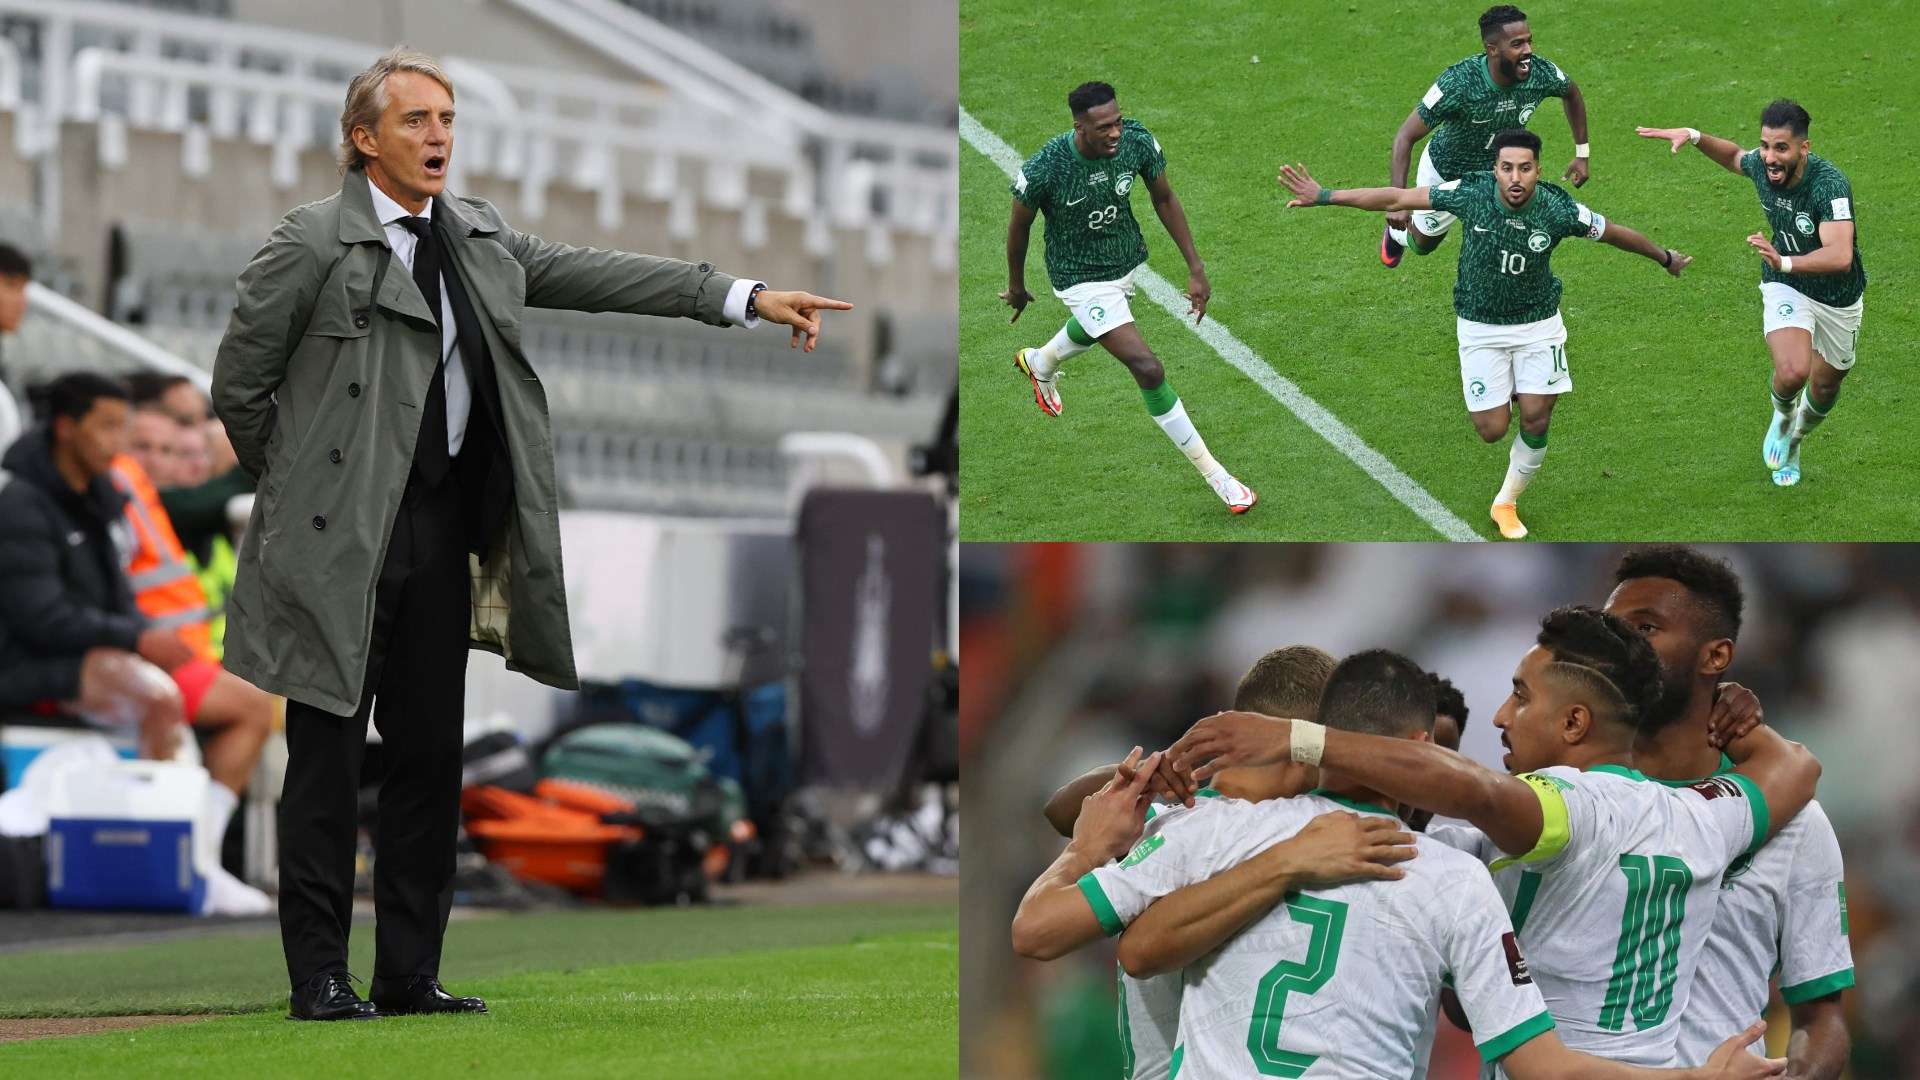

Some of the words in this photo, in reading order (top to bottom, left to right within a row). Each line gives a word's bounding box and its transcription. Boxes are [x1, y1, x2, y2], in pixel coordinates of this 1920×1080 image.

[1089, 205, 1117, 230] 23
[1780, 230, 1800, 252] 11
[1501, 250, 1526, 275] 10
[1597, 854, 1693, 1032] 10
[1246, 891, 1349, 1080] 2
